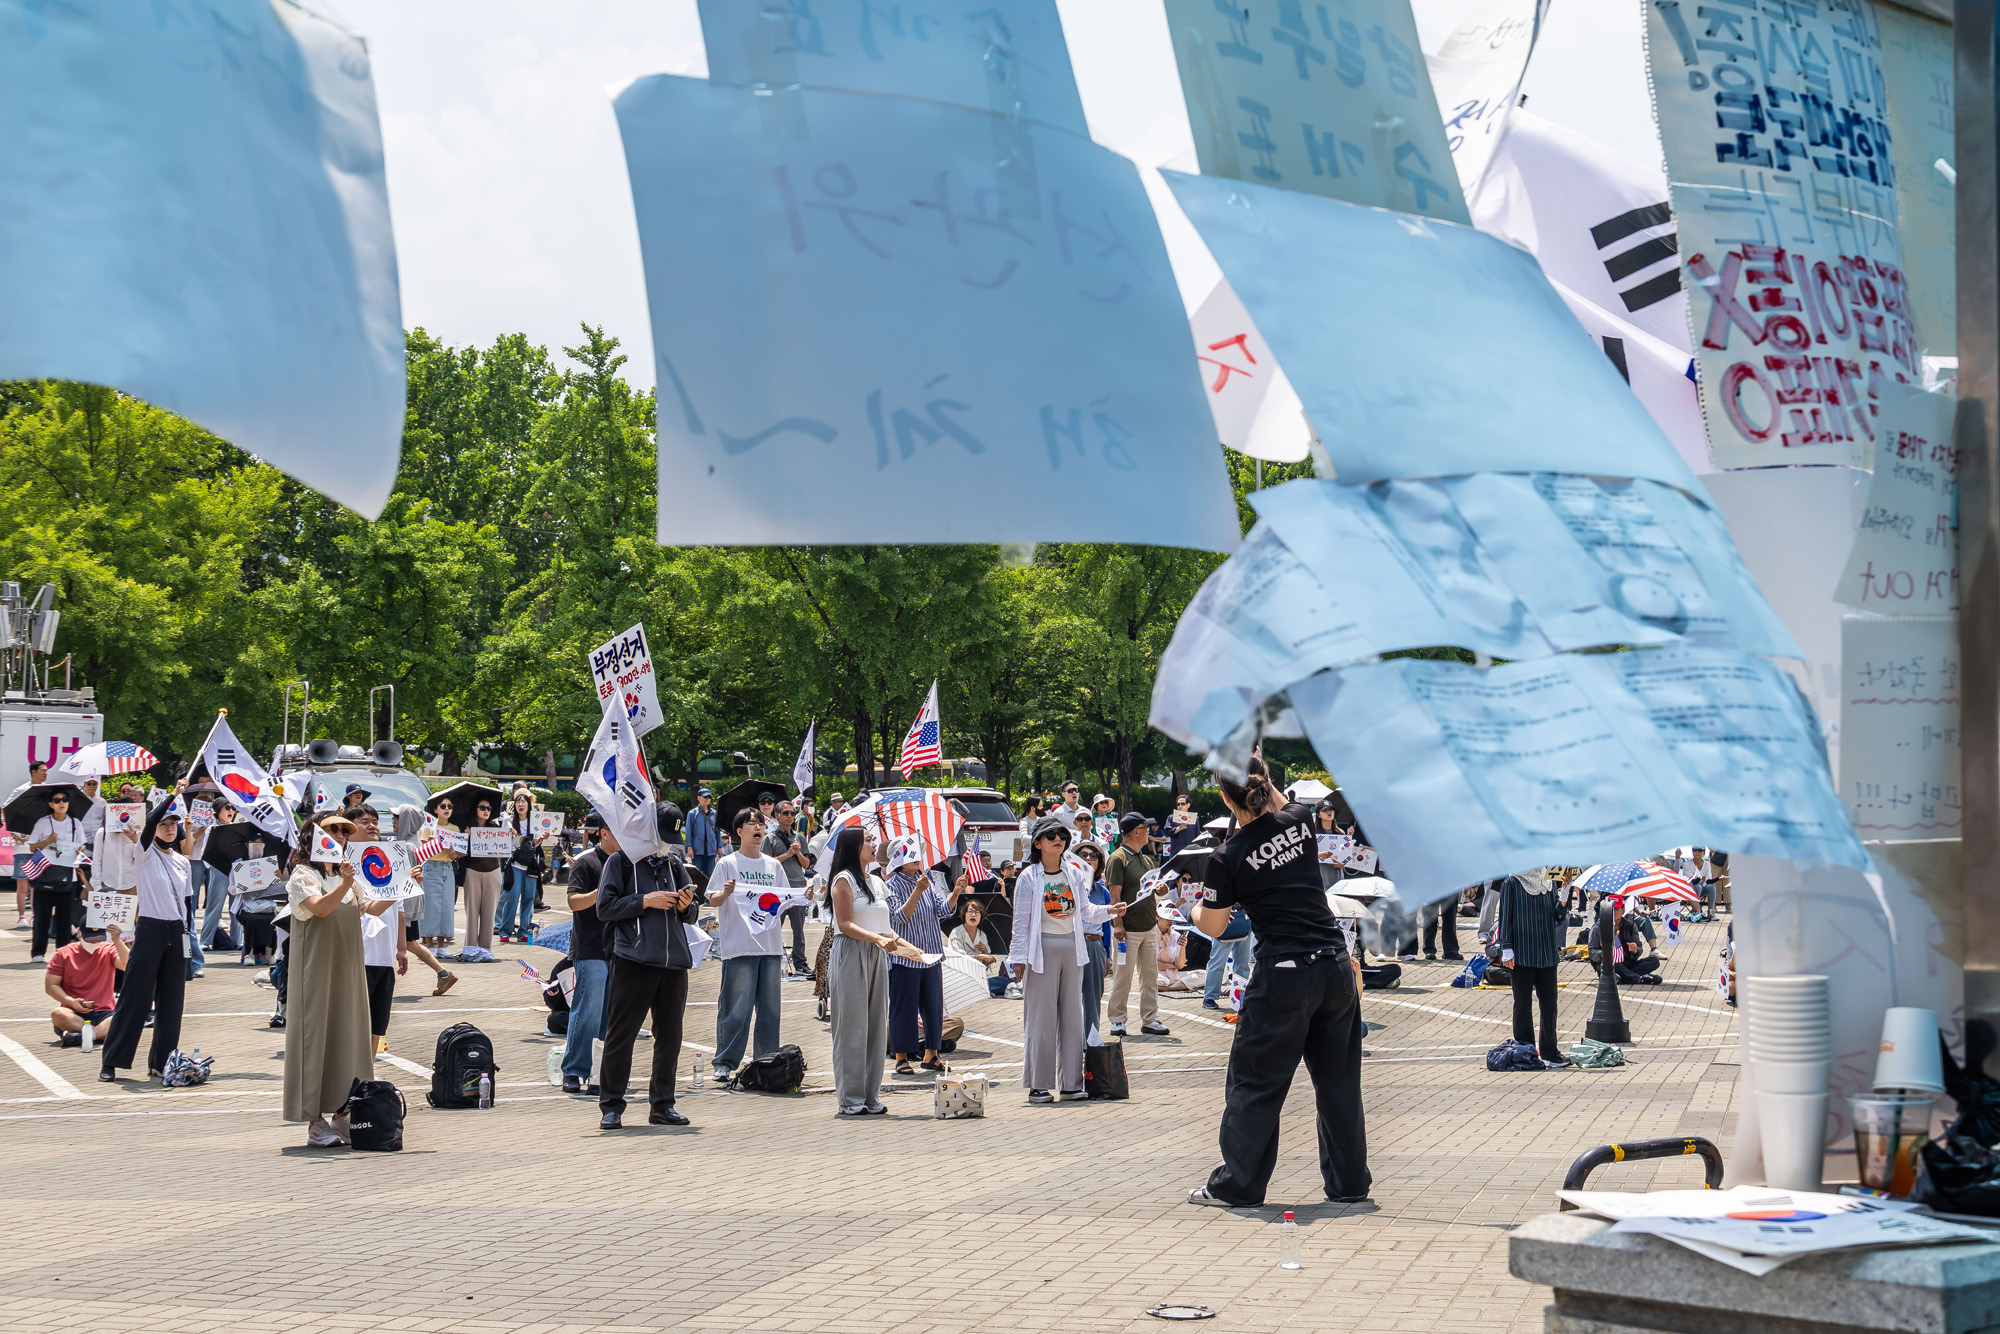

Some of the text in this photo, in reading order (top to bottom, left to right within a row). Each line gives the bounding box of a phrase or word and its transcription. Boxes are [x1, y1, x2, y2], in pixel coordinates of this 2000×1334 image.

[593, 630, 646, 681] 부정선거
[28, 735, 83, 770] U+
[1245, 822, 1313, 871] KOREA
[1271, 843, 1304, 870] ARMY
[739, 871, 775, 881] Maltese
[93, 894, 133, 910] 당일투표
[99, 910, 128, 924] 수개표
[350, 1121, 373, 1130] ANGOL
